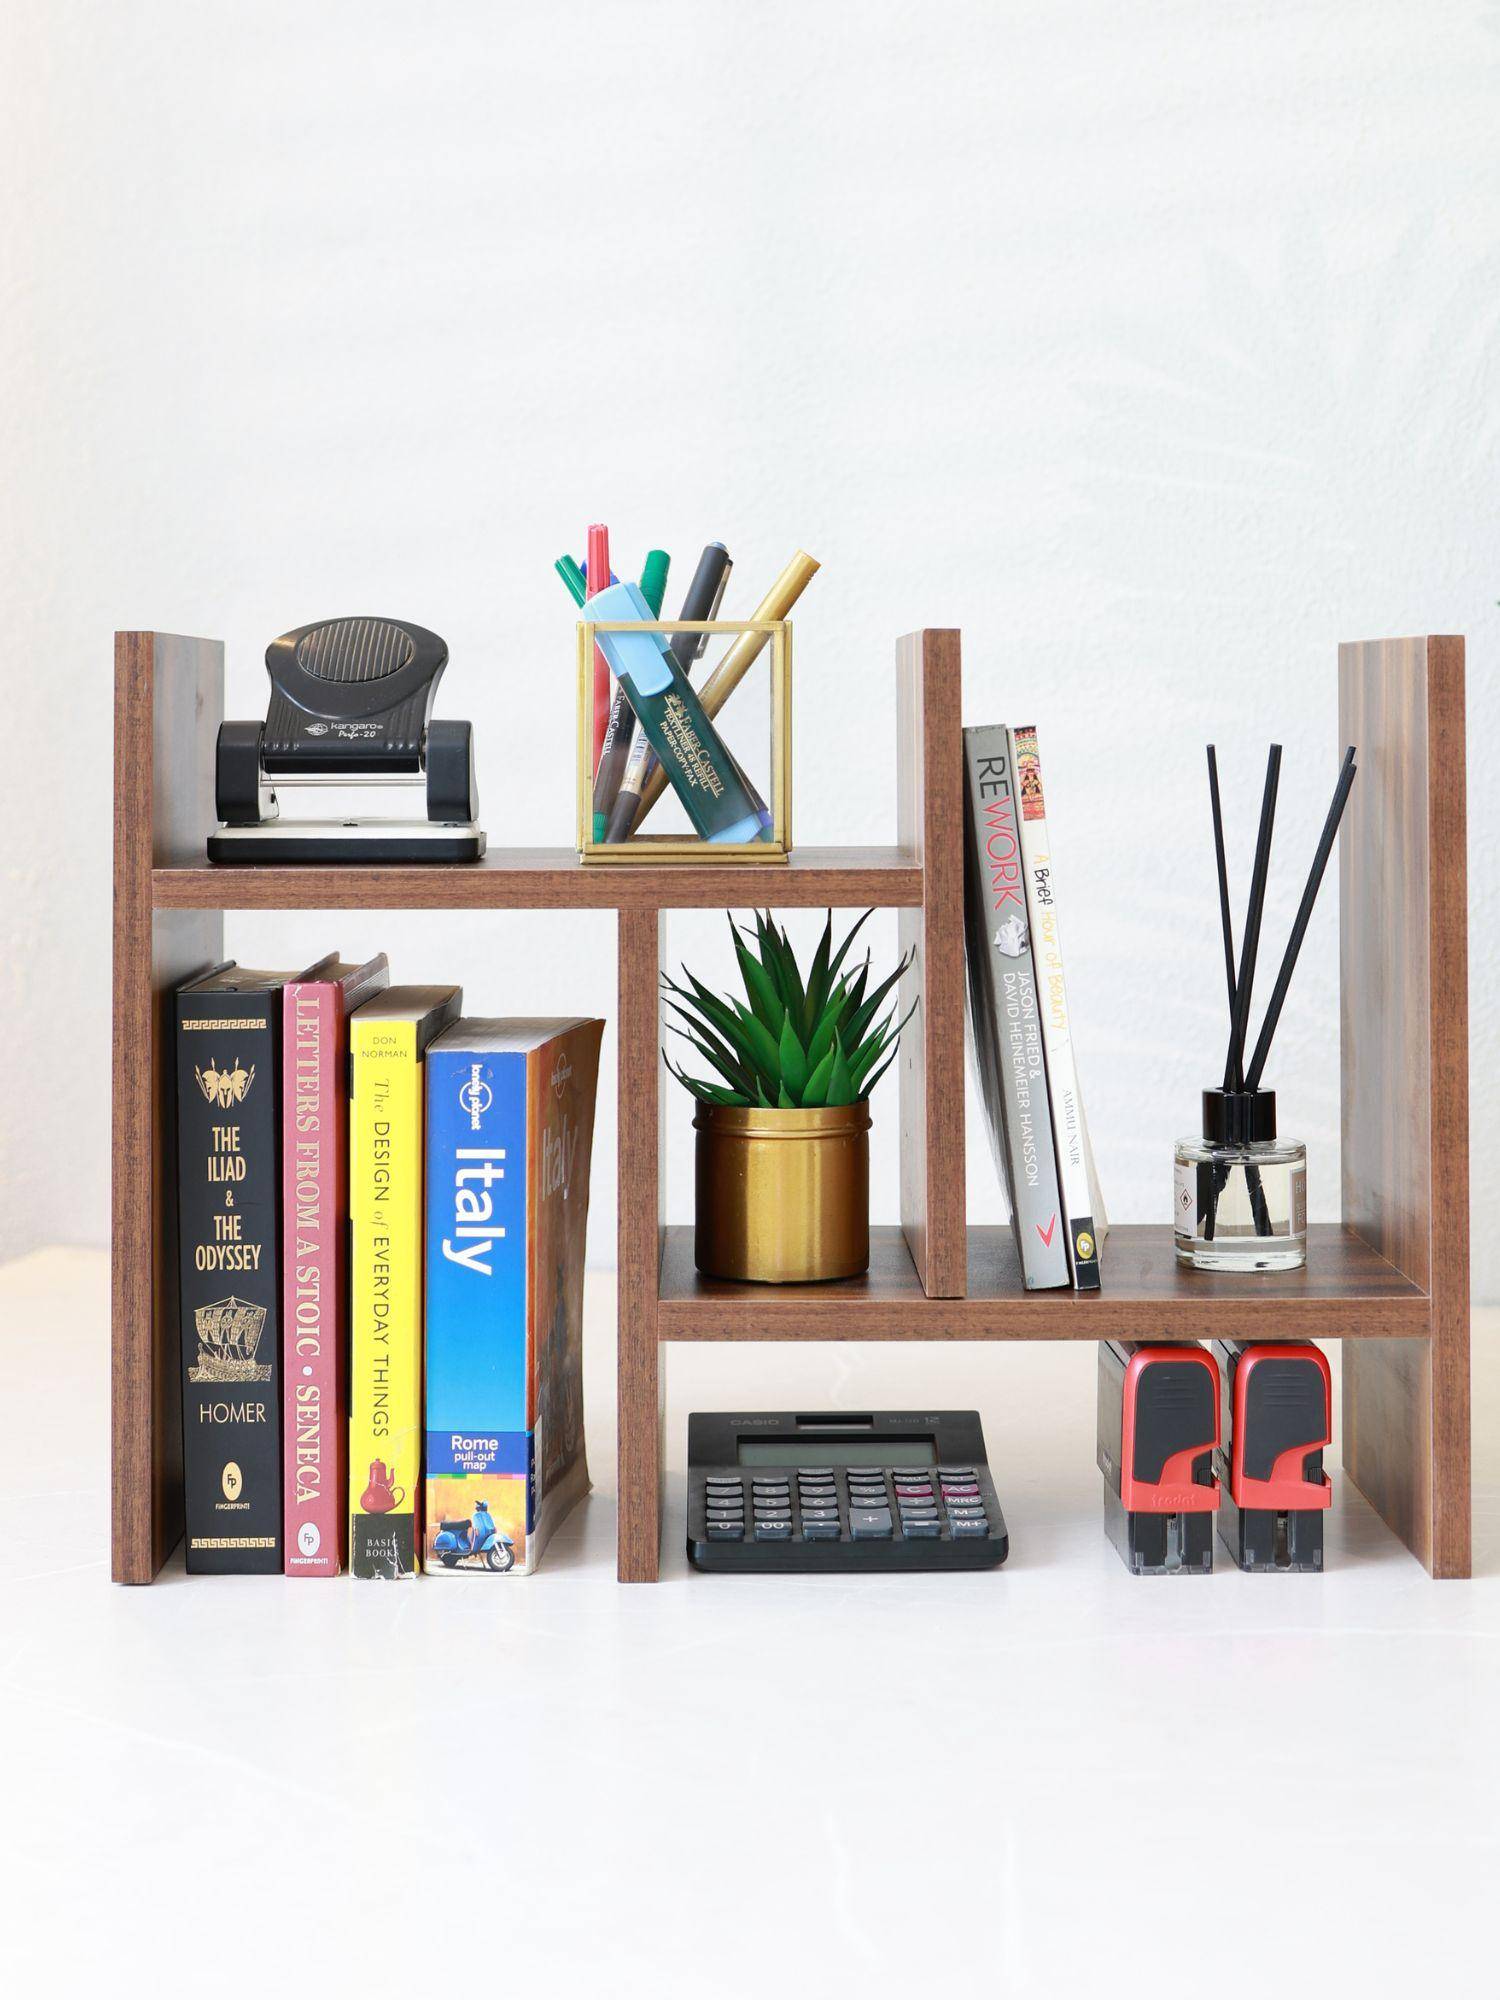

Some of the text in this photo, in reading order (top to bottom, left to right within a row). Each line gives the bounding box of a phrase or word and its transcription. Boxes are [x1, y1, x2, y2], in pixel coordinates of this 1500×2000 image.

[664, 706, 690, 753] TEXTLINER
[692, 763, 711, 792] REFILL
[679, 715, 724, 796] FABER-CASTELL
[977, 756, 1023, 911] REWORK
[1033, 855, 1048, 864] A
[1034, 868, 1054, 905] Brief
[1046, 953, 1062, 969] of
[1018, 971, 1041, 1079] JASON FRIED &
[373, 1036, 397, 1045] DON
[362, 1050, 407, 1058] NORMAN
[1004, 973, 1039, 1187] DAVID HEINEMEIER HANSSON
[468, 1064, 483, 1130] lonely planet
[212, 1127, 240, 1152] THE
[1063, 1089, 1080, 1166] AMMU NAIR
[208, 1156, 246, 1182] ILIAD
[542, 1114, 578, 1201] Italy
[225, 1190, 234, 1207] &
[442, 1149, 506, 1276] Italy
[213, 1215, 242, 1240] THE
[195, 1244, 261, 1271] ODYSSEY
[296, 997, 320, 1505] LETTERS FROM A STOIC SENECA
[370, 1078, 390, 1437] The DESIGN of EVERYDAY THINGS
[200, 1402, 266, 1424] HOMER
[451, 1435, 499, 1451] Rome
[454, 1451, 495, 1463] pull-out
[463, 1461, 487, 1470] map
[366, 1549, 399, 1557] BOOKS
[367, 1538, 398, 1547] BASIC
